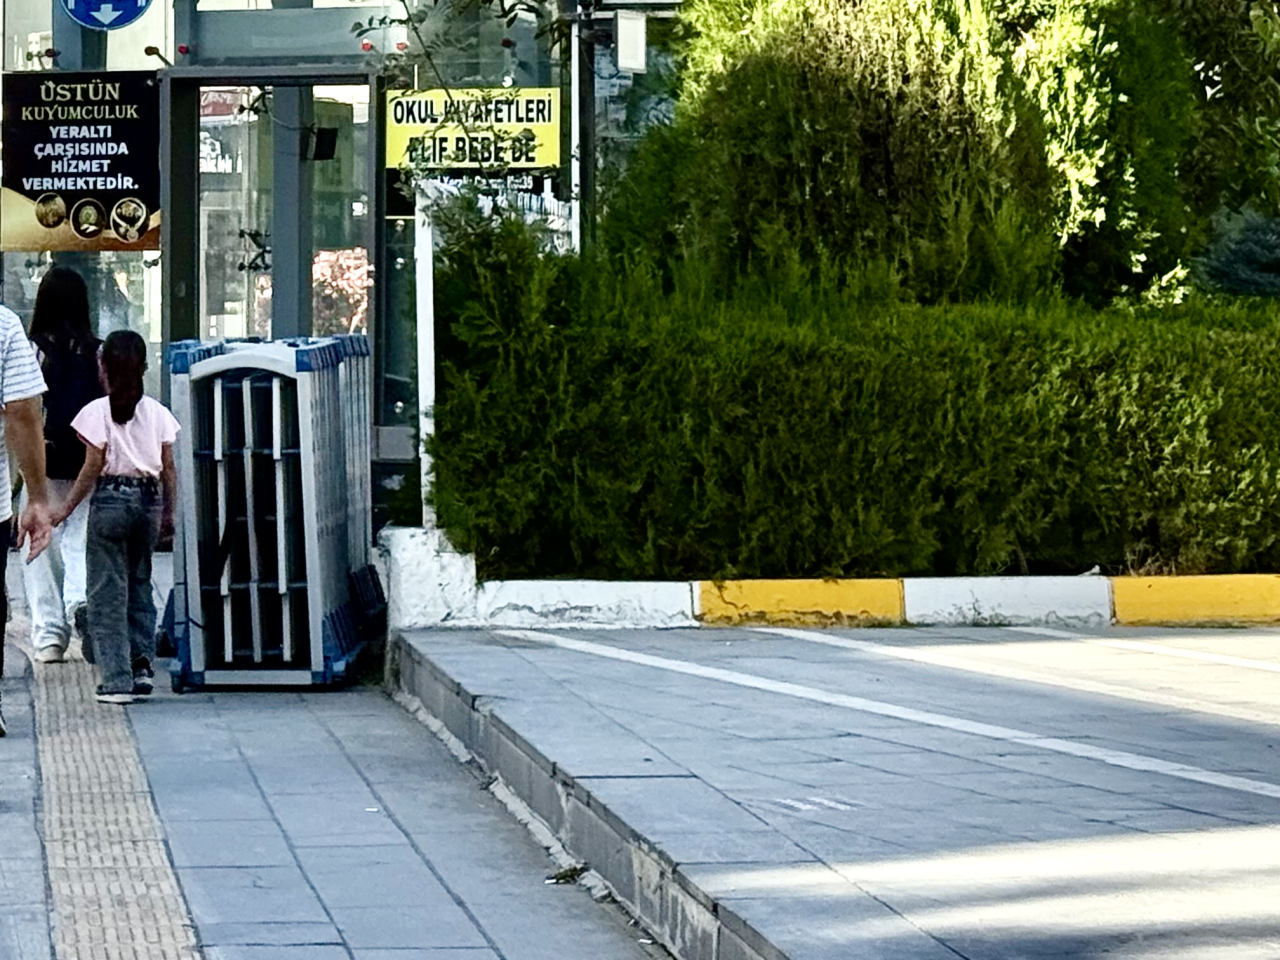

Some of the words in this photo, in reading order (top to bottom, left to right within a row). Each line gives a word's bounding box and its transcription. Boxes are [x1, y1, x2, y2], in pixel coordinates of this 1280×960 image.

[40, 79, 121, 102] ÜSTÜN
[21, 104, 140, 121] KUYUMCULUK
[393, 100, 438, 124] OKUL
[49, 125, 112, 139] YERALTI
[33, 142, 129, 160] ÇARŞISINDA
[51, 157, 111, 173] HİZMET
[22, 173, 139, 191] VERMEKTEDİR.
